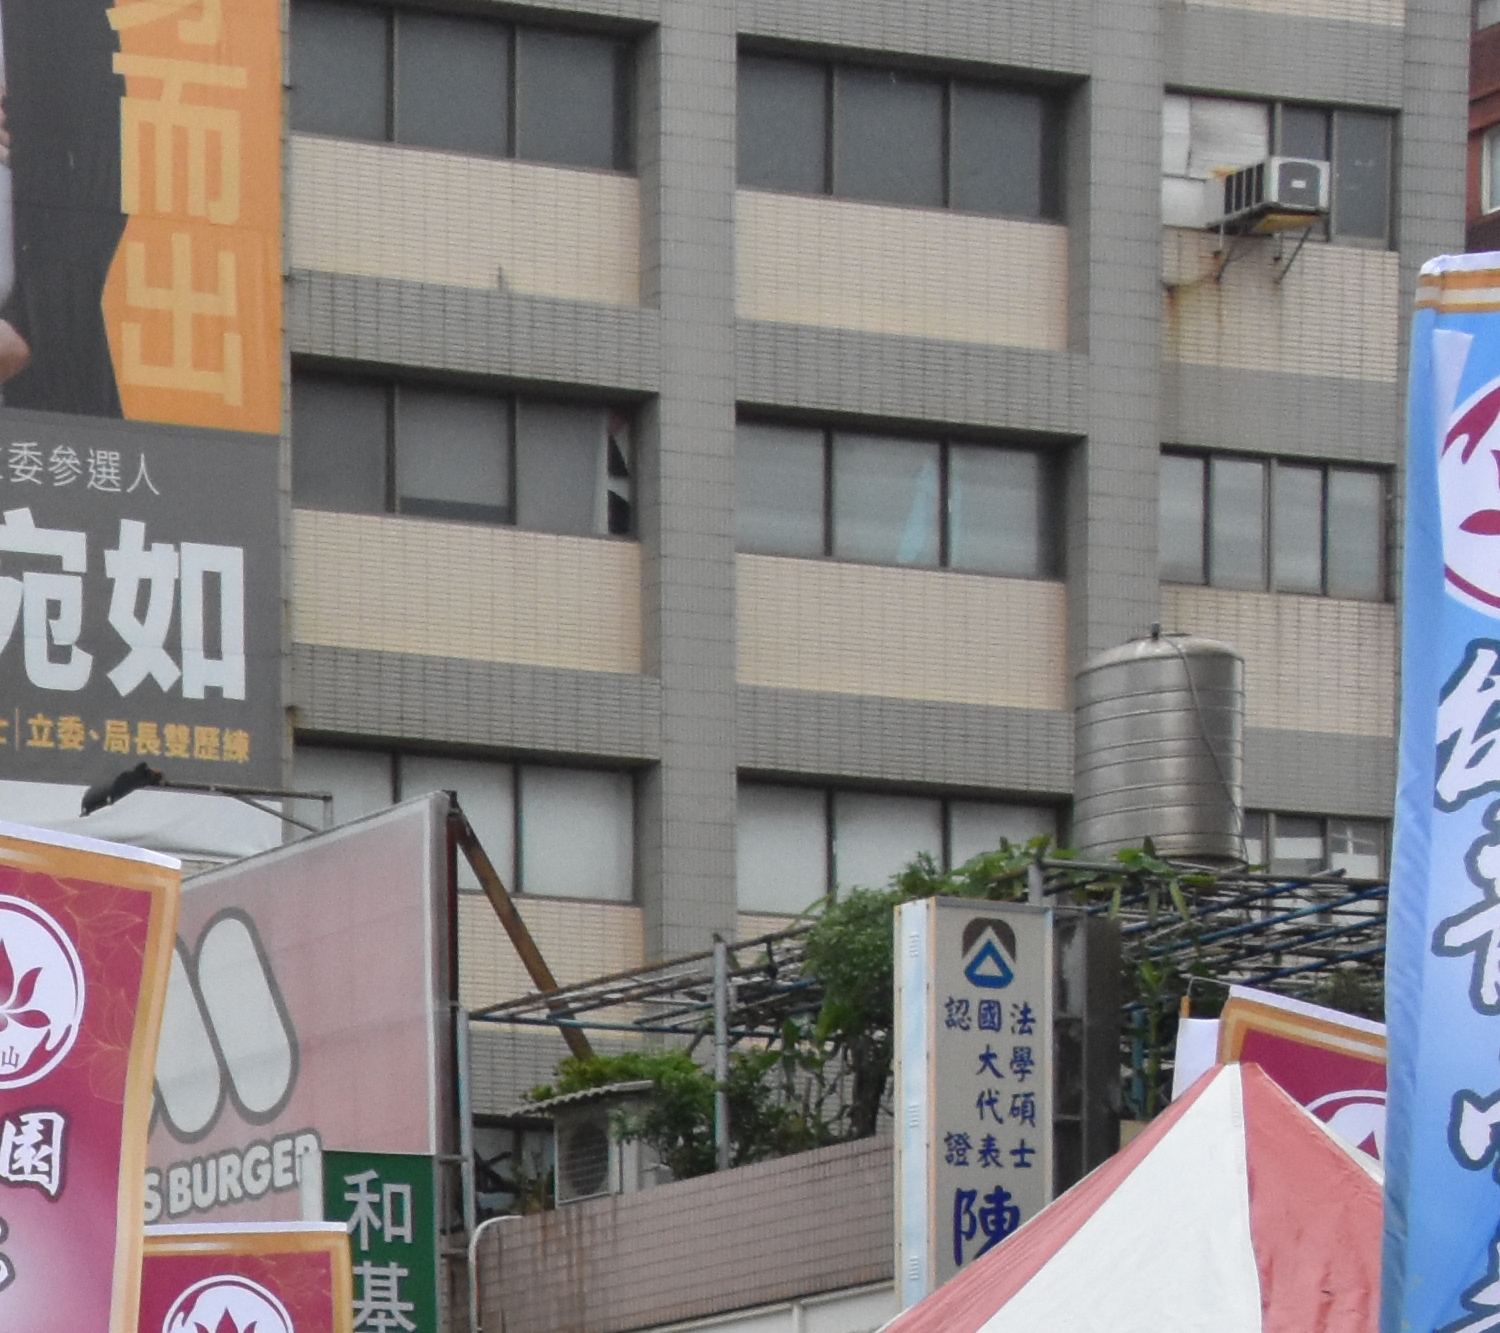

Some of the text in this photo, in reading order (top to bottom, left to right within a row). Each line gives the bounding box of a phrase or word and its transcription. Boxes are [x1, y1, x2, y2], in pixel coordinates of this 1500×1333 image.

[106, 0, 248, 407] 而出
[976, 1000, 1006, 1169] 國大代表
[1008, 1003, 1037, 1169] 法學碩士
[168, 1132, 319, 1214] BURGER
[953, 1184, 1021, 1267] 陳
